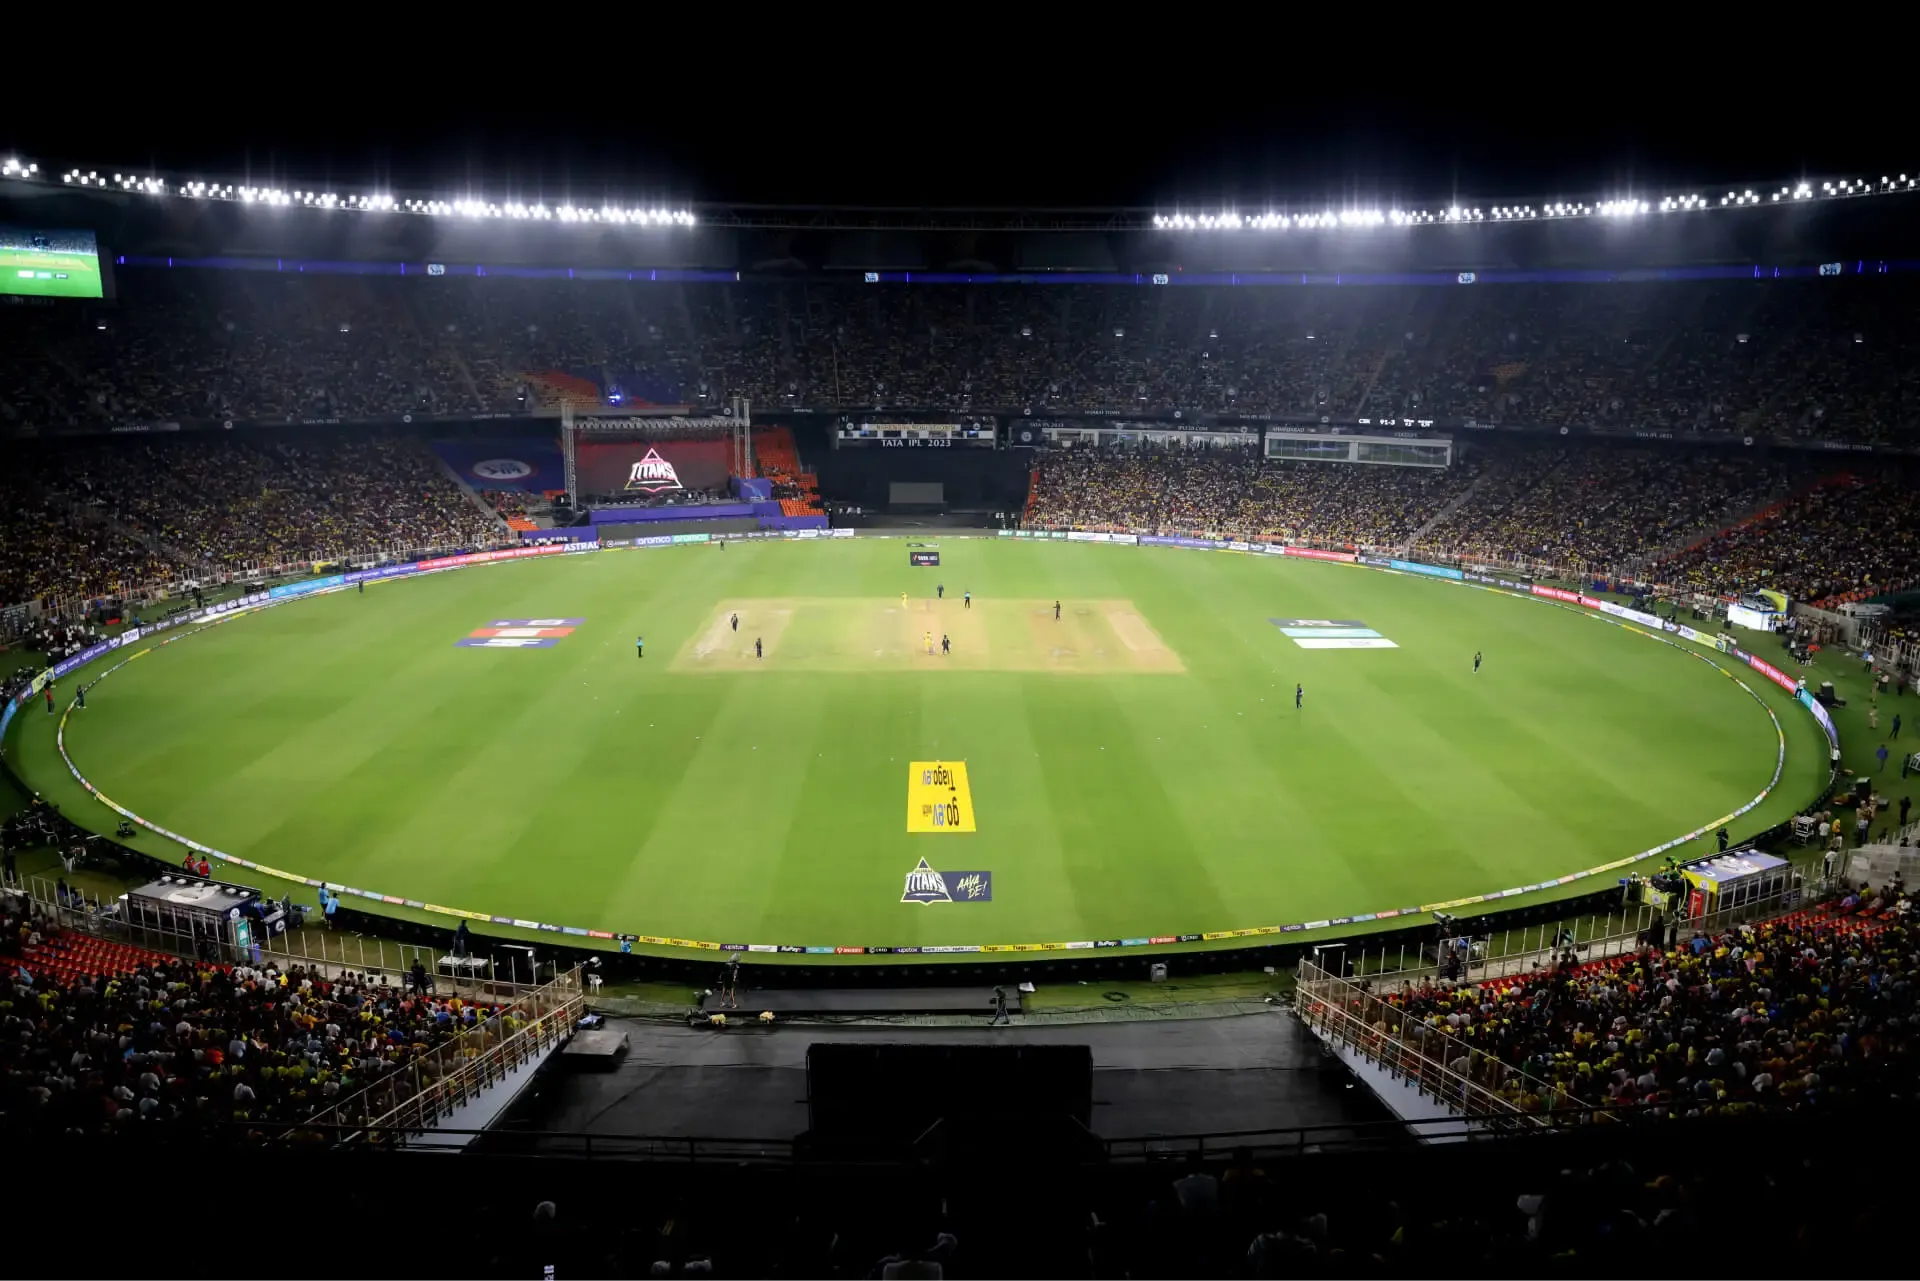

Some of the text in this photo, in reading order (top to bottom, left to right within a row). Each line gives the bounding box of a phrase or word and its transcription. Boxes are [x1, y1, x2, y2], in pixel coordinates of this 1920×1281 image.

[881, 439, 952, 447] TATA IPL 2023
[630, 461, 677, 481] TITANS
[637, 536, 671, 545] aramco
[563, 541, 600, 552] ASTRAL
[905, 872, 947, 893] TITANS
